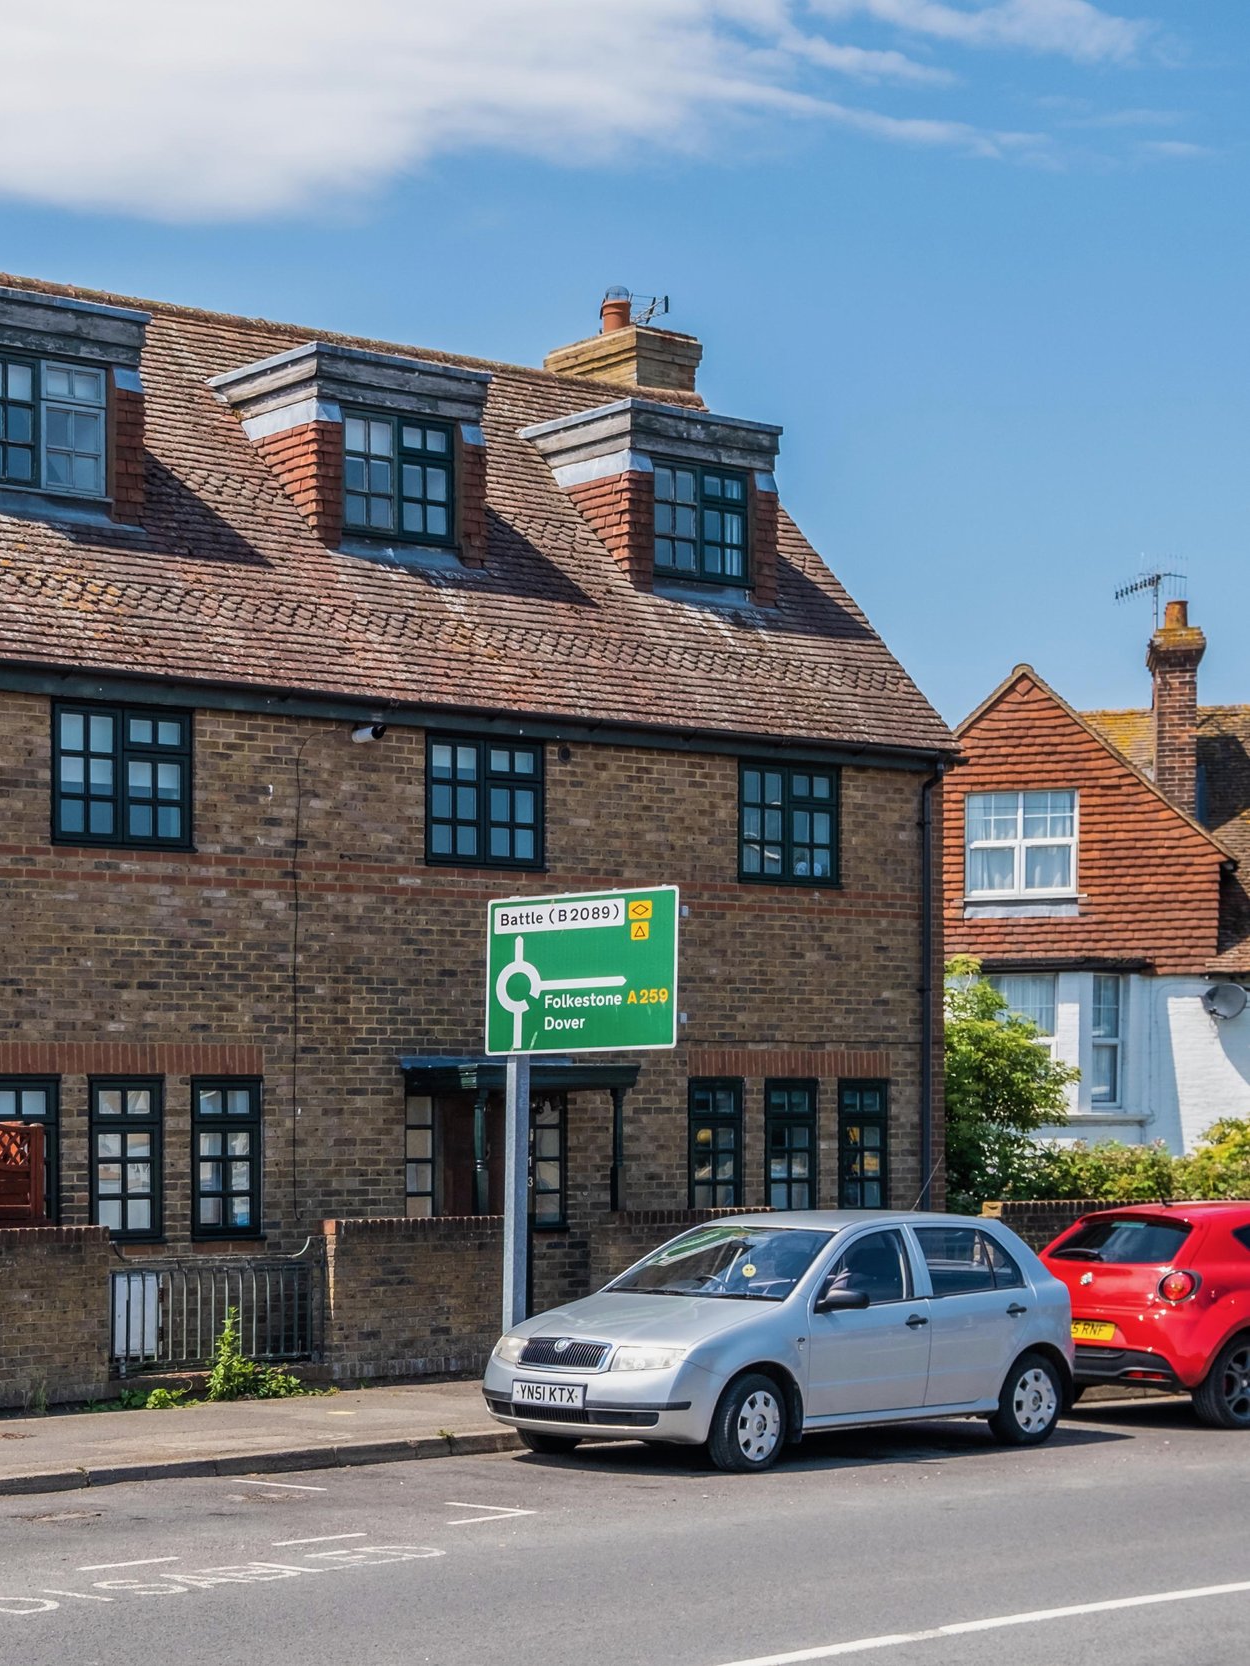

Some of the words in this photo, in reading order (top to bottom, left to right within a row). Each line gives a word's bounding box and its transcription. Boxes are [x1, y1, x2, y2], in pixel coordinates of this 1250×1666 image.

[500, 911, 544, 927] Battle
[548, 903, 620, 925] (B2089)
[544, 992, 623, 1009] Folkestone
[627, 988, 669, 1004] A259
[544, 1016, 586, 1031] Dover
[1081, 1322, 1108, 1336] RNF
[520, 1384, 546, 1401] YN51
[549, 1387, 575, 1403] KTX
